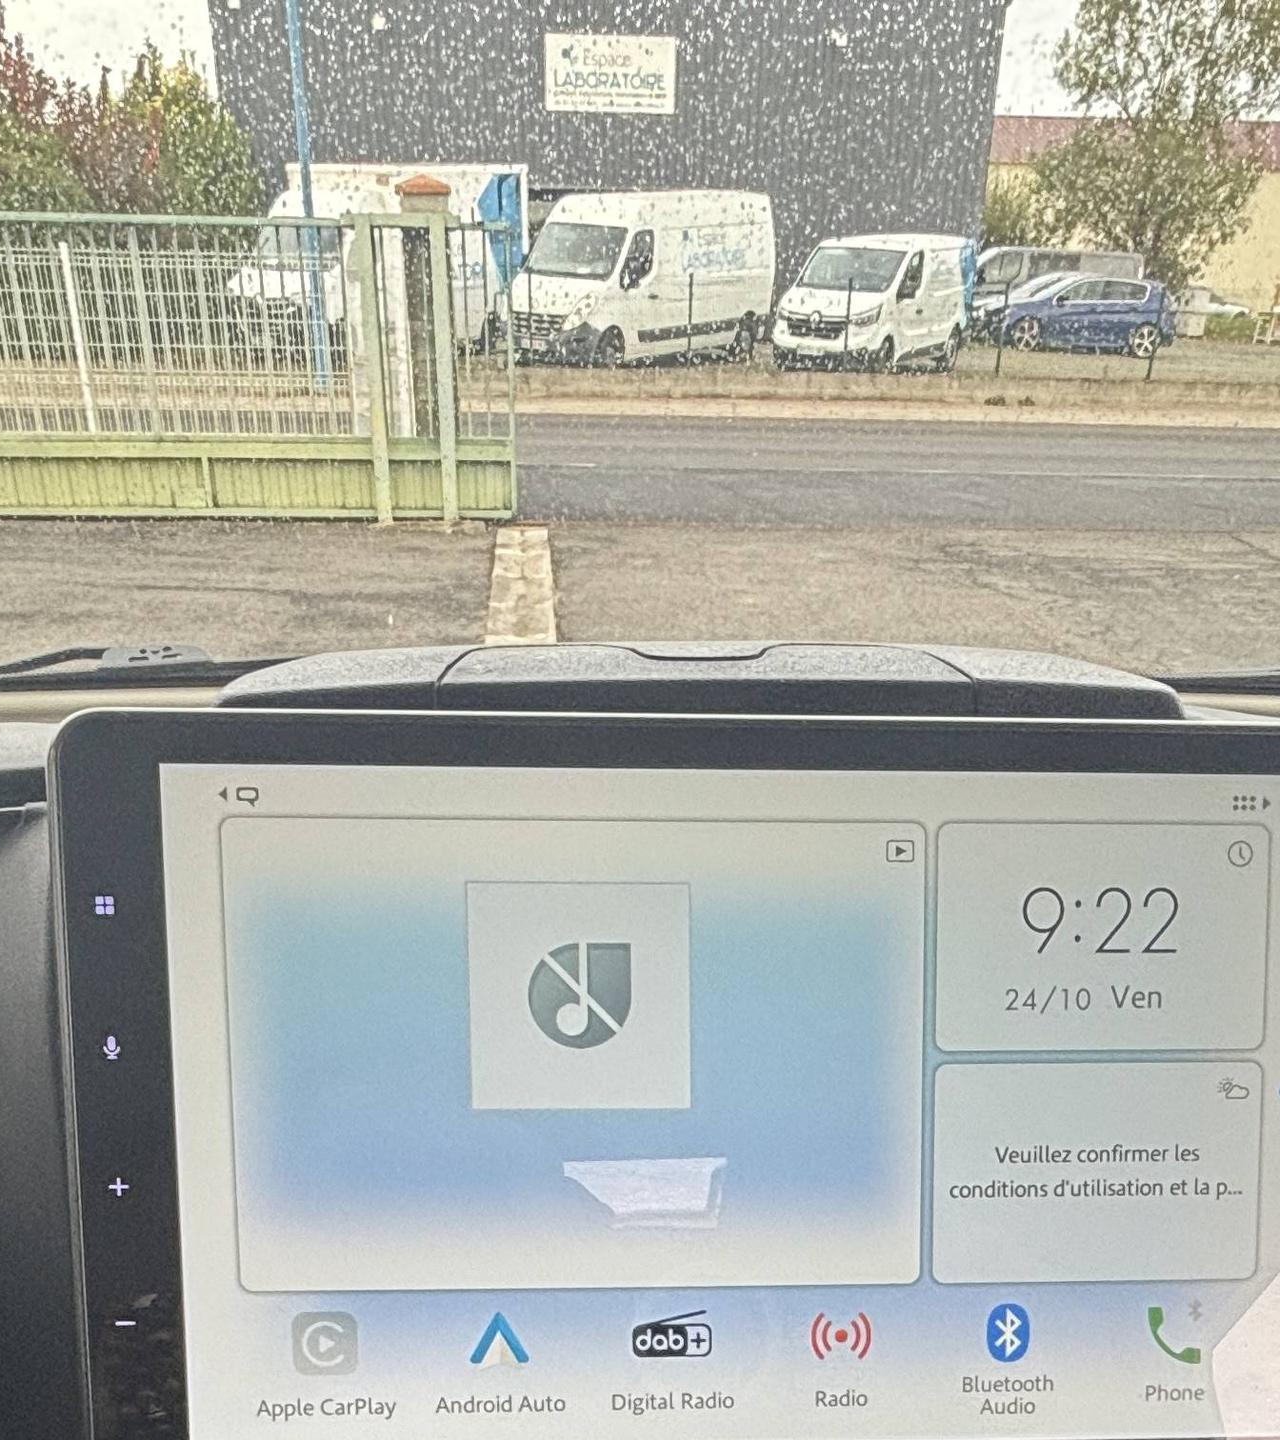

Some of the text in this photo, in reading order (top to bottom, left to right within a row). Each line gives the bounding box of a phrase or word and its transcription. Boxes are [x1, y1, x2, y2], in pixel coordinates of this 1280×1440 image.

[583, 48, 631, 69] Espace
[553, 69, 665, 90] LABORATOIRE
[1022, 887, 1179, 955] 9:22
[1005, 985, 1163, 1014] 24/10 Ven
[995, 1144, 1200, 1164] Veuillez confirmer les
[949, 1177, 1244, 1201] conditions d'utilisation et la p...
[961, 1374, 1055, 1394] Bluetooth
[1144, 1384, 1205, 1402] Phone
[256, 1397, 398, 1421] Apple CarPlay
[435, 1394, 566, 1415] Android Auto
[611, 1391, 735, 1416] Digital Radio
[815, 1390, 869, 1408] Radio
[979, 1397, 1036, 1415] Audio
